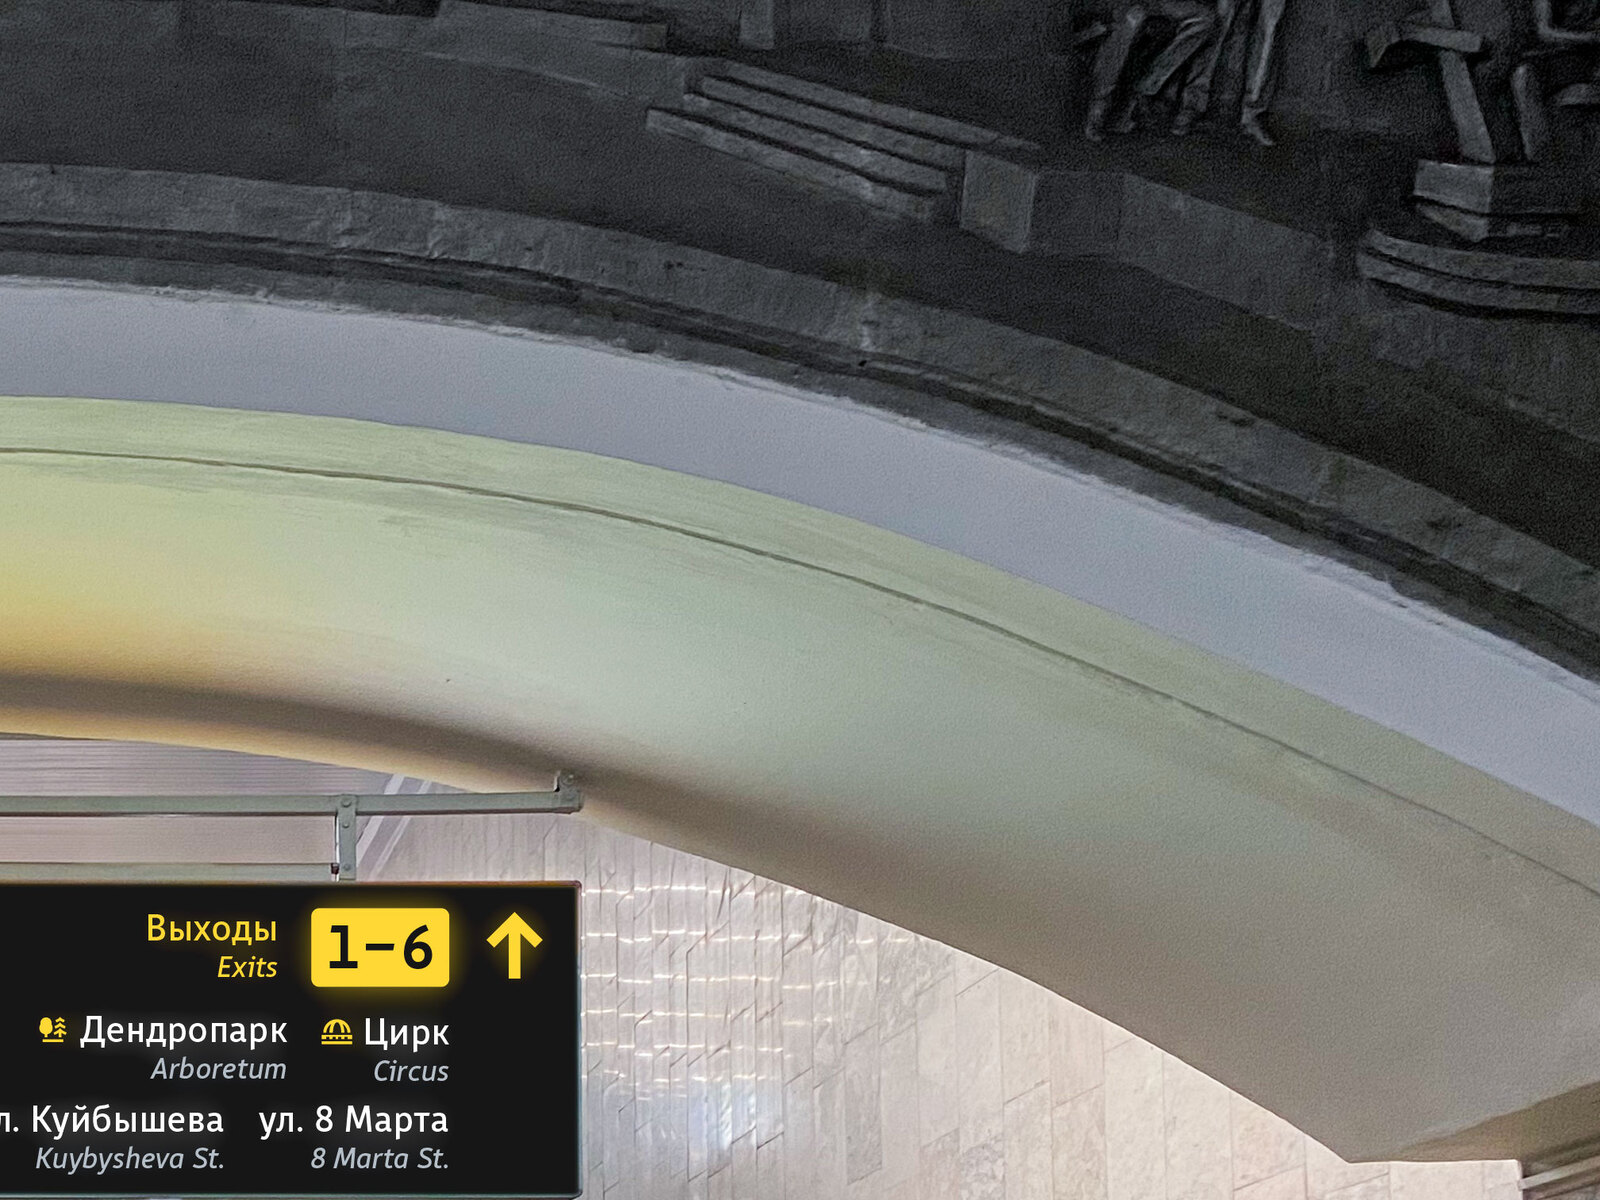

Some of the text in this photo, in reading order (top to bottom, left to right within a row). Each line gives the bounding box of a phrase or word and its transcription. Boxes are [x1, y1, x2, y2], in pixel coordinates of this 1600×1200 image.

[147, 913, 277, 945] Выходы
[217, 955, 278, 978] Exits
[80, 1016, 288, 1050] Дендропарк
[365, 1017, 449, 1052] Цирк
[151, 1056, 287, 1080] Arboretum
[374, 1060, 449, 1082] Circus
[32, 1104, 224, 1138] Куйбышева
[258, 1104, 449, 1141] ул. 8 Марта
[35, 1146, 224, 1175] Kuybysheva St.
[310, 1147, 449, 1169] 8 Marta St.
